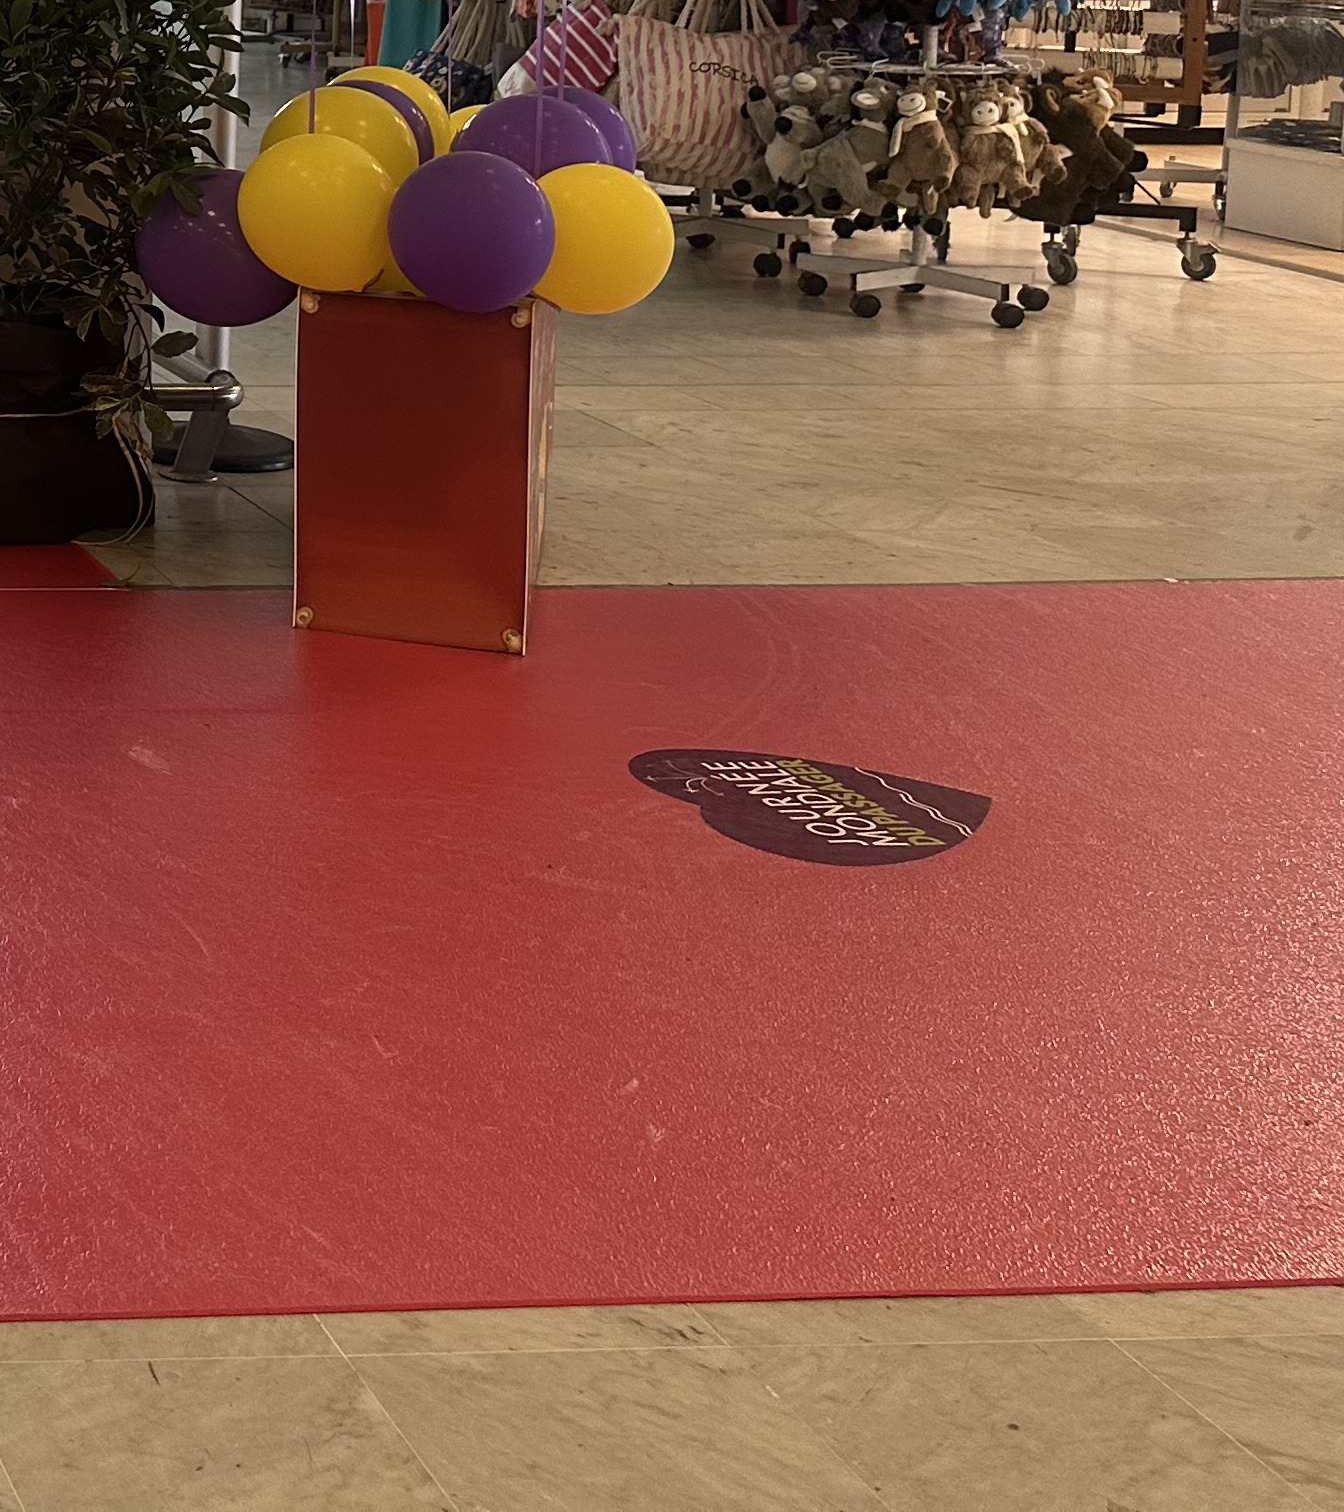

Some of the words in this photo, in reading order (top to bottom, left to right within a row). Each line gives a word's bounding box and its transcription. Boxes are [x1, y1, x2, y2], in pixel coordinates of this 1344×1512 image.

[688, 61, 759, 88] CORSICA
[700, 760, 869, 846] JOURNÉE
[738, 760, 911, 847] MONDIALE
[775, 759, 910, 825] PASSAGER
[887, 826, 947, 847] DU
